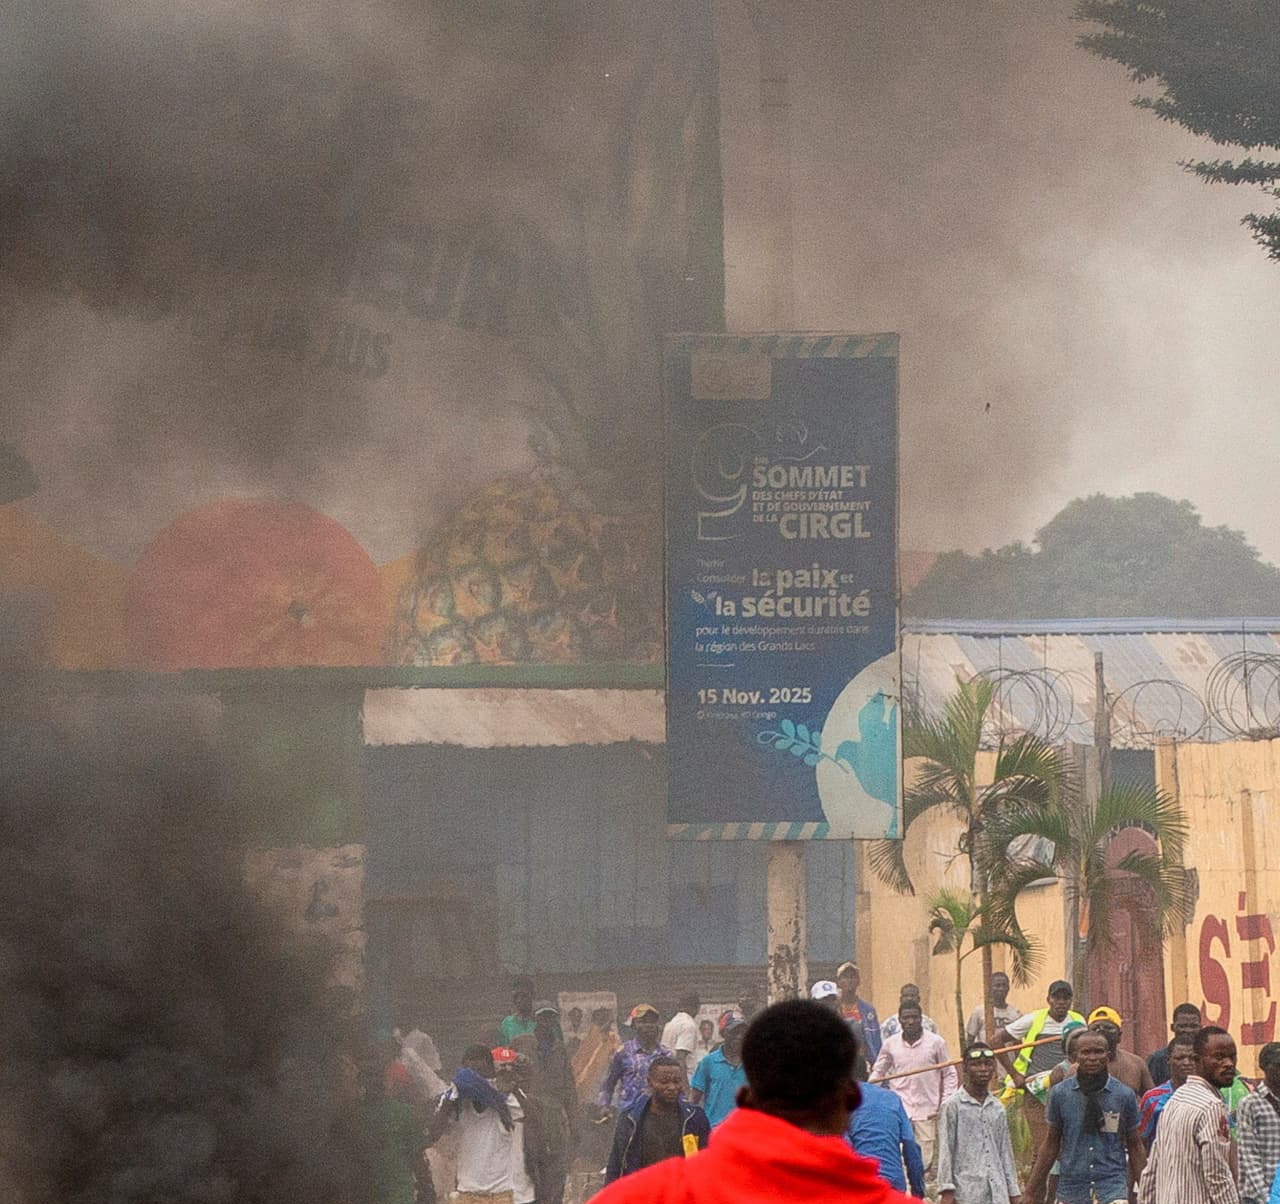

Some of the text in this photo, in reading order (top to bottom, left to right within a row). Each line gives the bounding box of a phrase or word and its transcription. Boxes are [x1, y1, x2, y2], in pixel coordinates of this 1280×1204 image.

[752, 465, 871, 488] SOMMET
[752, 488, 843, 501] DES CHEFS D'ÉTAT
[752, 501, 872, 512] ET DE GOUVERNEMENT
[766, 514, 778, 523] LA
[779, 513, 871, 540] CIRGL
[752, 567, 772, 587] la
[777, 562, 839, 596] paix
[840, 573, 855, 584] et
[715, 589, 871, 617] la sécurité
[695, 626, 719, 637] pour
[721, 624, 731, 635] le
[732, 624, 805, 638] développement
[695, 642, 704, 653] la
[705, 641, 738, 655] région
[740, 641, 756, 652] des
[758, 640, 793, 652] Grands
[698, 687, 812, 704] 15 Nov. 2025
